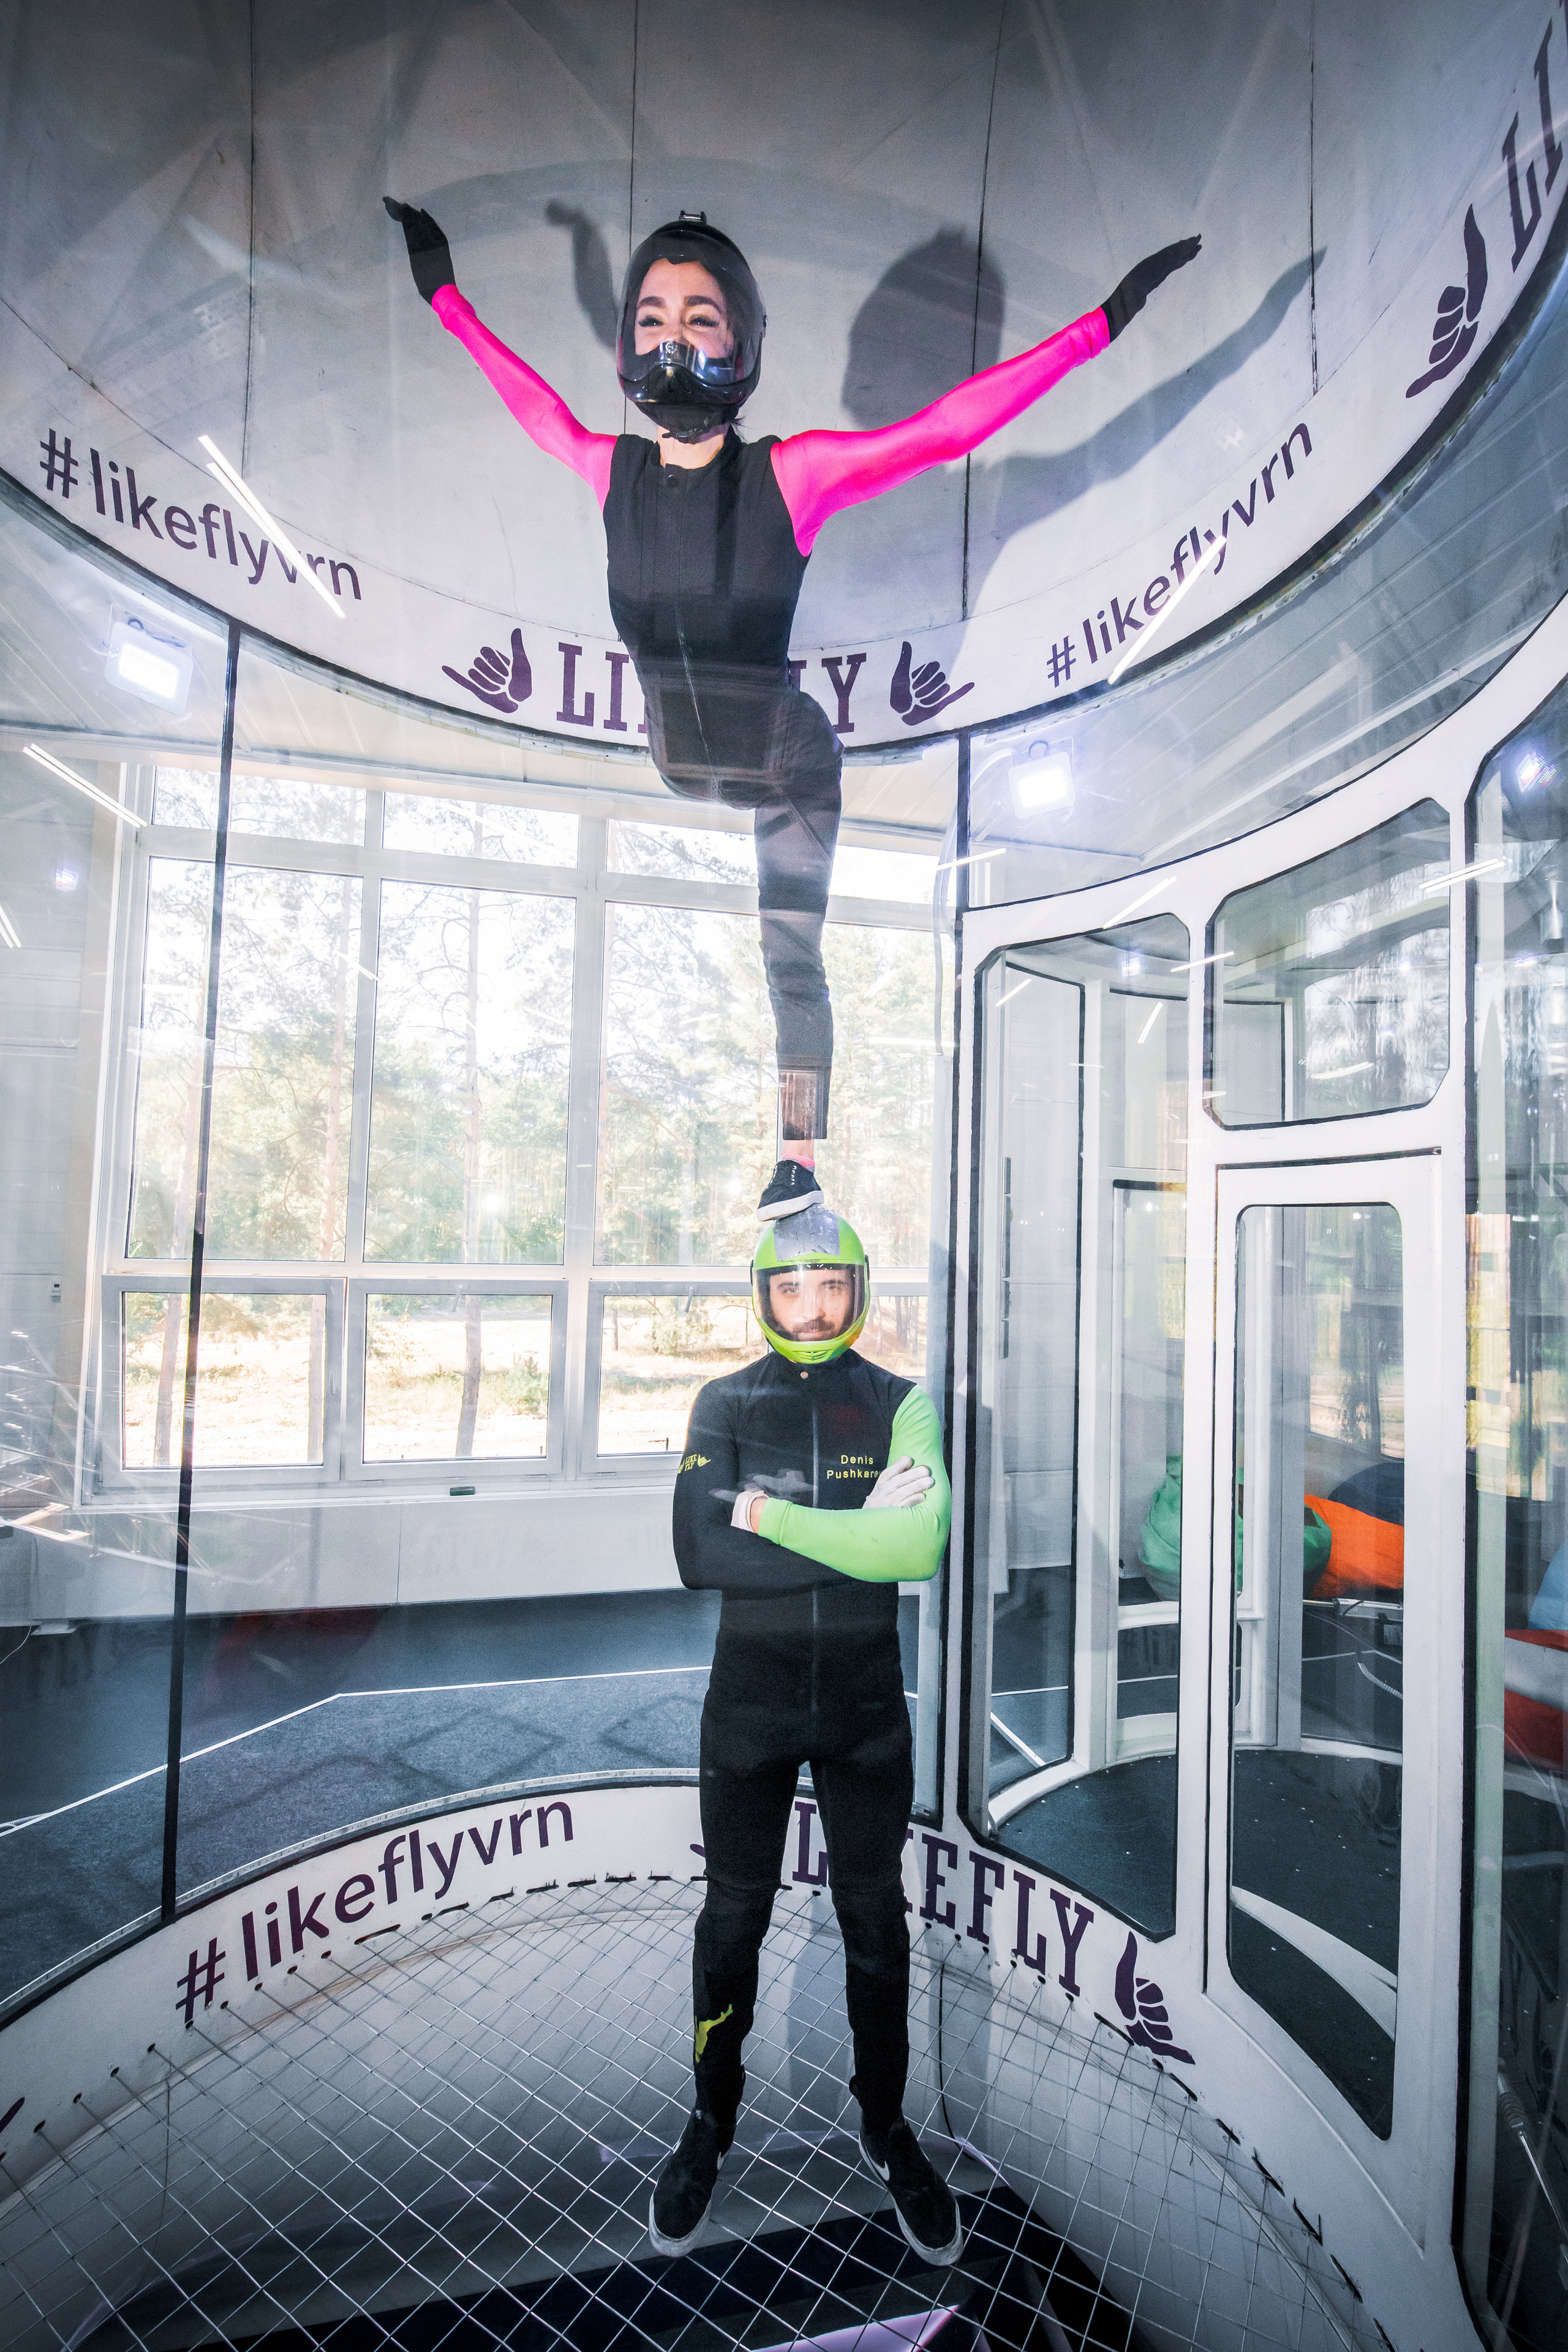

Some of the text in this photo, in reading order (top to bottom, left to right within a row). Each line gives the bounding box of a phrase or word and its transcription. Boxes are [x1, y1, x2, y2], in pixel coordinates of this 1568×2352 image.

[40, 428, 361, 600] #likeflyvrn
[1047, 423, 1312, 688] #likeflyvrn
[840, 1455, 873, 1464] Denis
[175, 1801, 574, 2021] #likeflyvrn
[792, 1801, 1094, 1997] LEFLY
